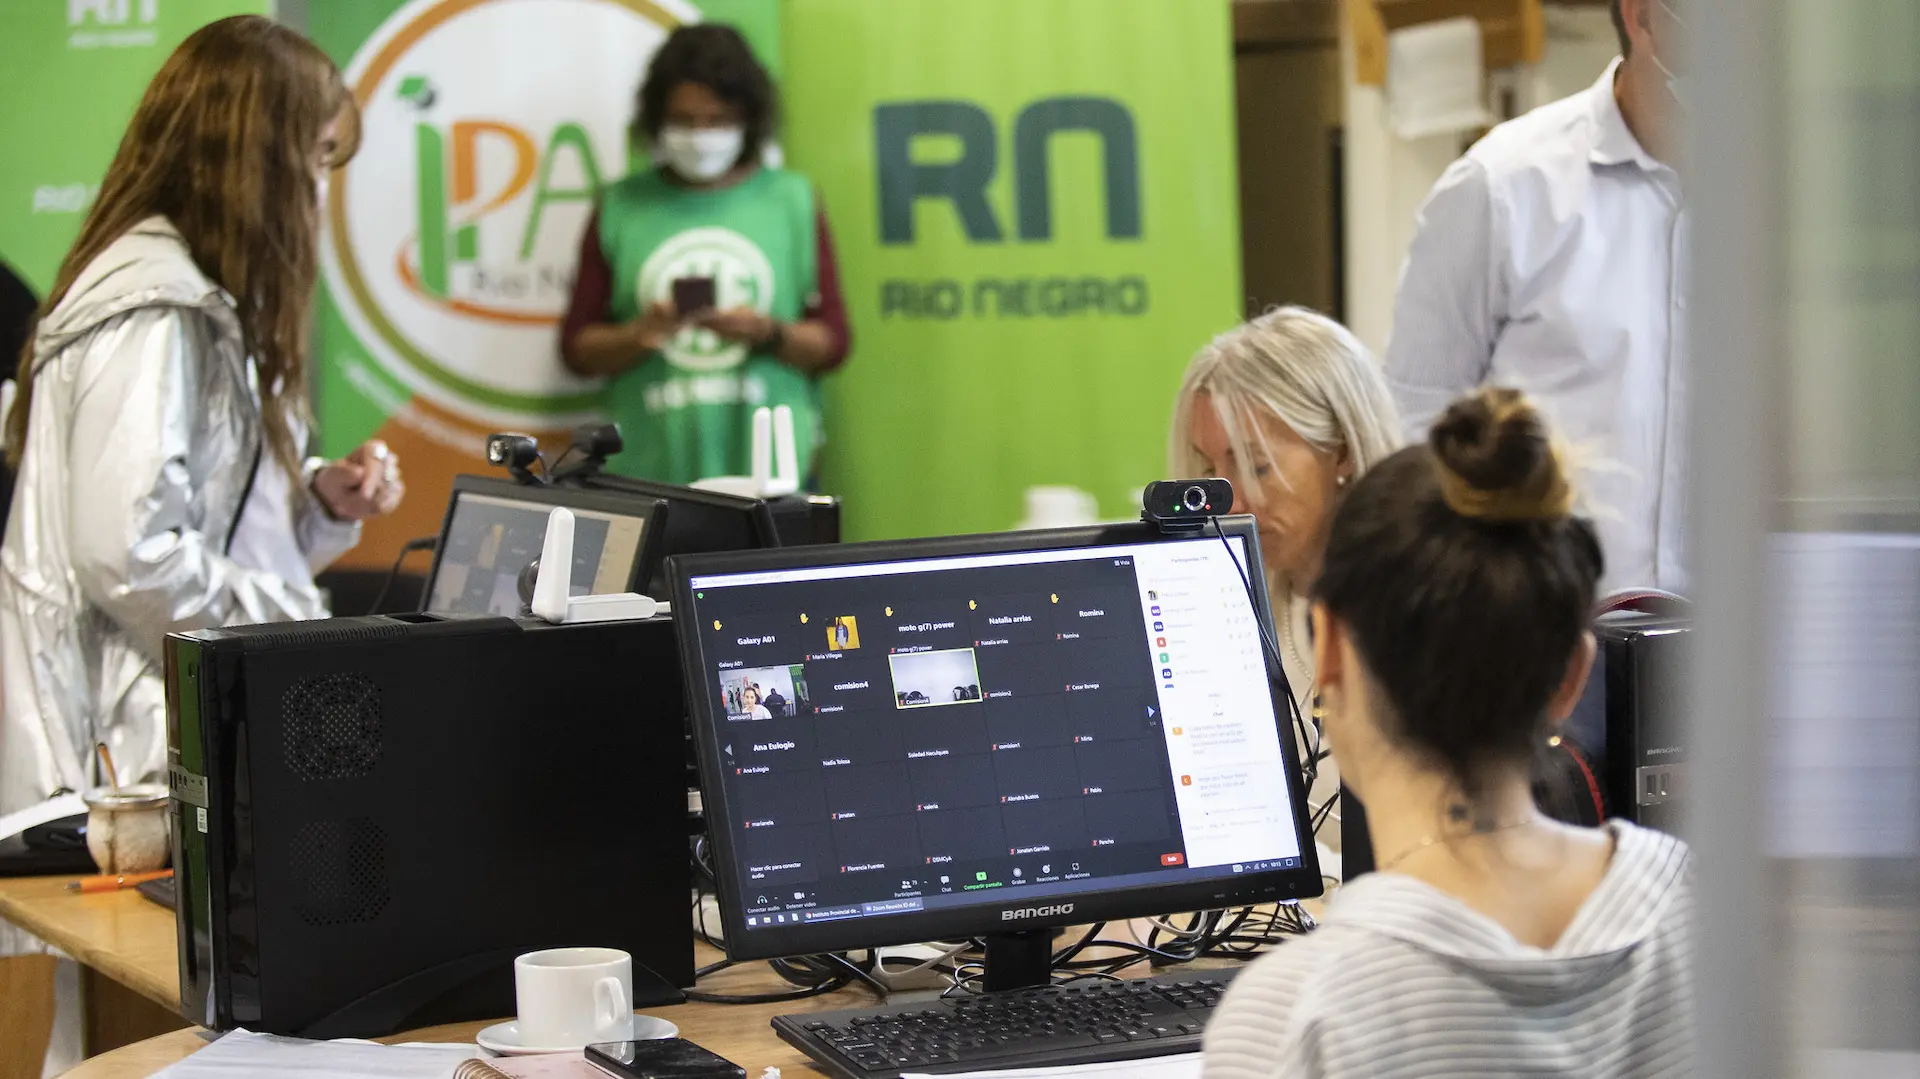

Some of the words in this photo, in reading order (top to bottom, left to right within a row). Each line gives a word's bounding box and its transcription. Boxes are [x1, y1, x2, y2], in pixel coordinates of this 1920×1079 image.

[880, 278, 963, 318] RIO
[973, 277, 1147, 316] NEGRO
[1079, 609, 1104, 617] Romina
[989, 616, 1012, 624] Natalia
[918, 623, 932, 632] g(7)
[933, 622, 955, 630] power
[737, 637, 761, 645] Galaxy
[834, 681, 869, 691] comision4
[753, 744, 767, 752] Ana
[768, 741, 795, 750] Eulogio
